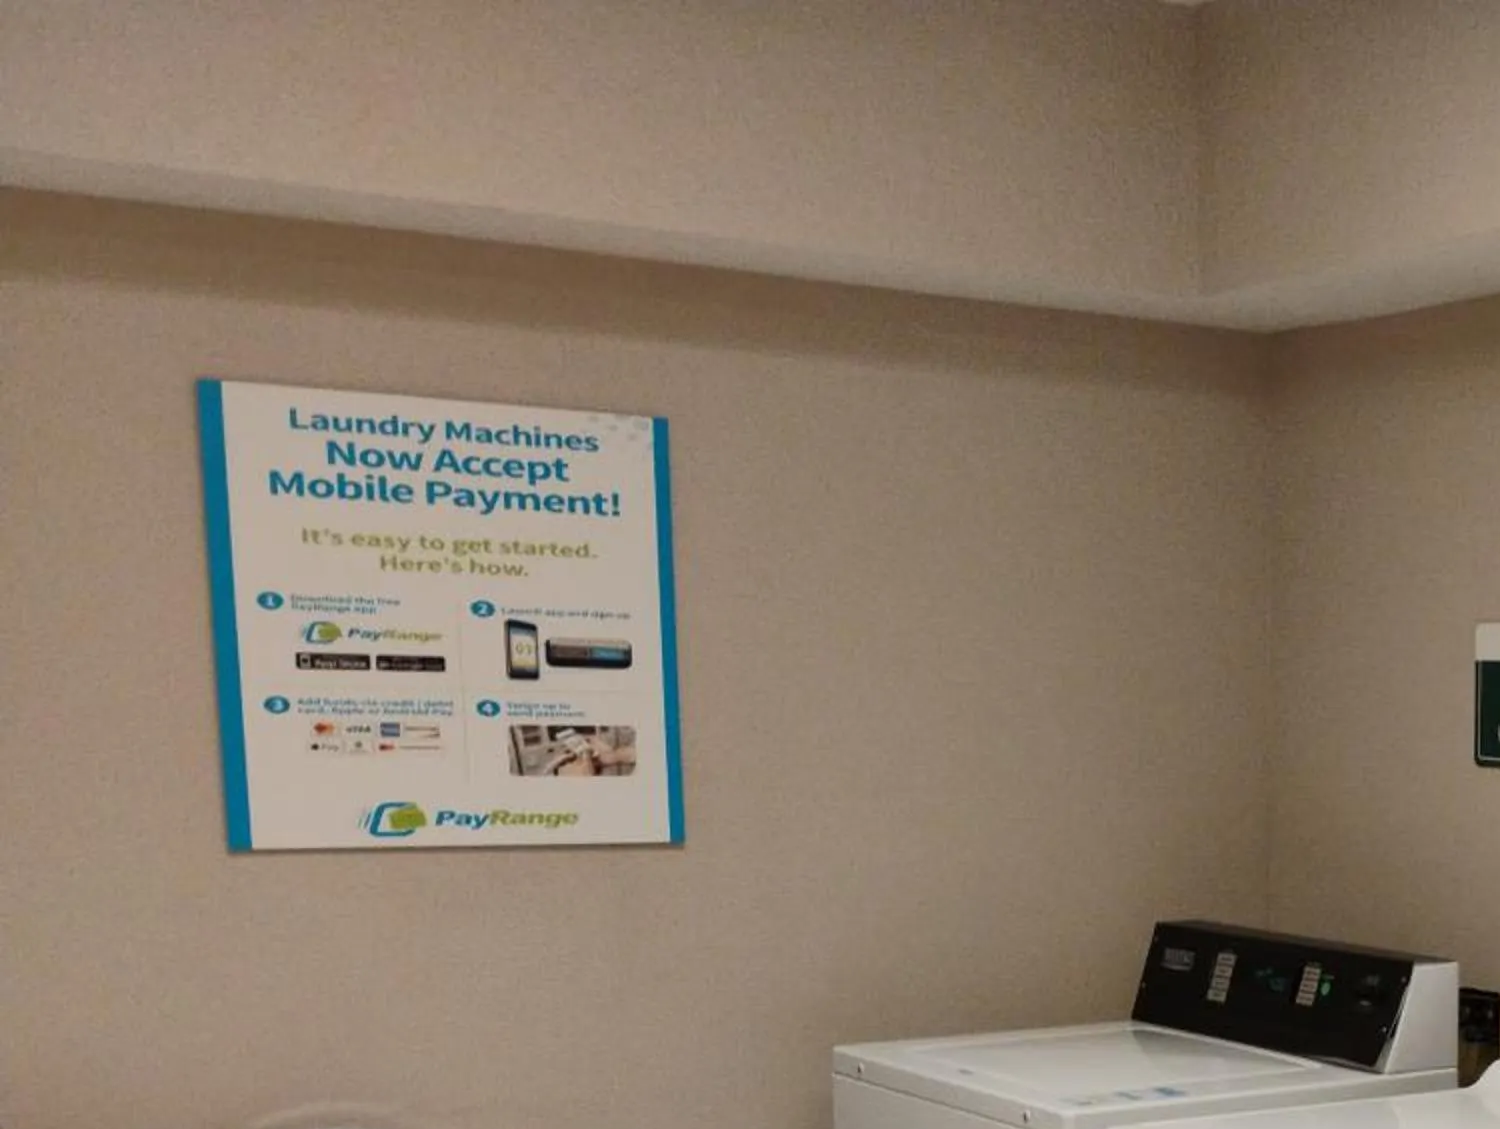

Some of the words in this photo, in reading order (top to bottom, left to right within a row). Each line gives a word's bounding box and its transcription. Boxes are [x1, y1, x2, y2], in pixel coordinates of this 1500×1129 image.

[289, 407, 436, 443] Laundry
[445, 420, 599, 452] Machines
[326, 440, 423, 472] Now
[434, 448, 569, 485] Accept
[268, 470, 414, 504] Mobile
[426, 481, 621, 517] Payment!
[302, 527, 344, 548] It's
[352, 533, 411, 554] easy
[419, 534, 445, 552] to
[452, 538, 493, 558] get
[500, 538, 598, 560] started.
[379, 554, 462, 574] Here's
[469, 557, 529, 577] how.
[435, 808, 579, 831] PayRange
